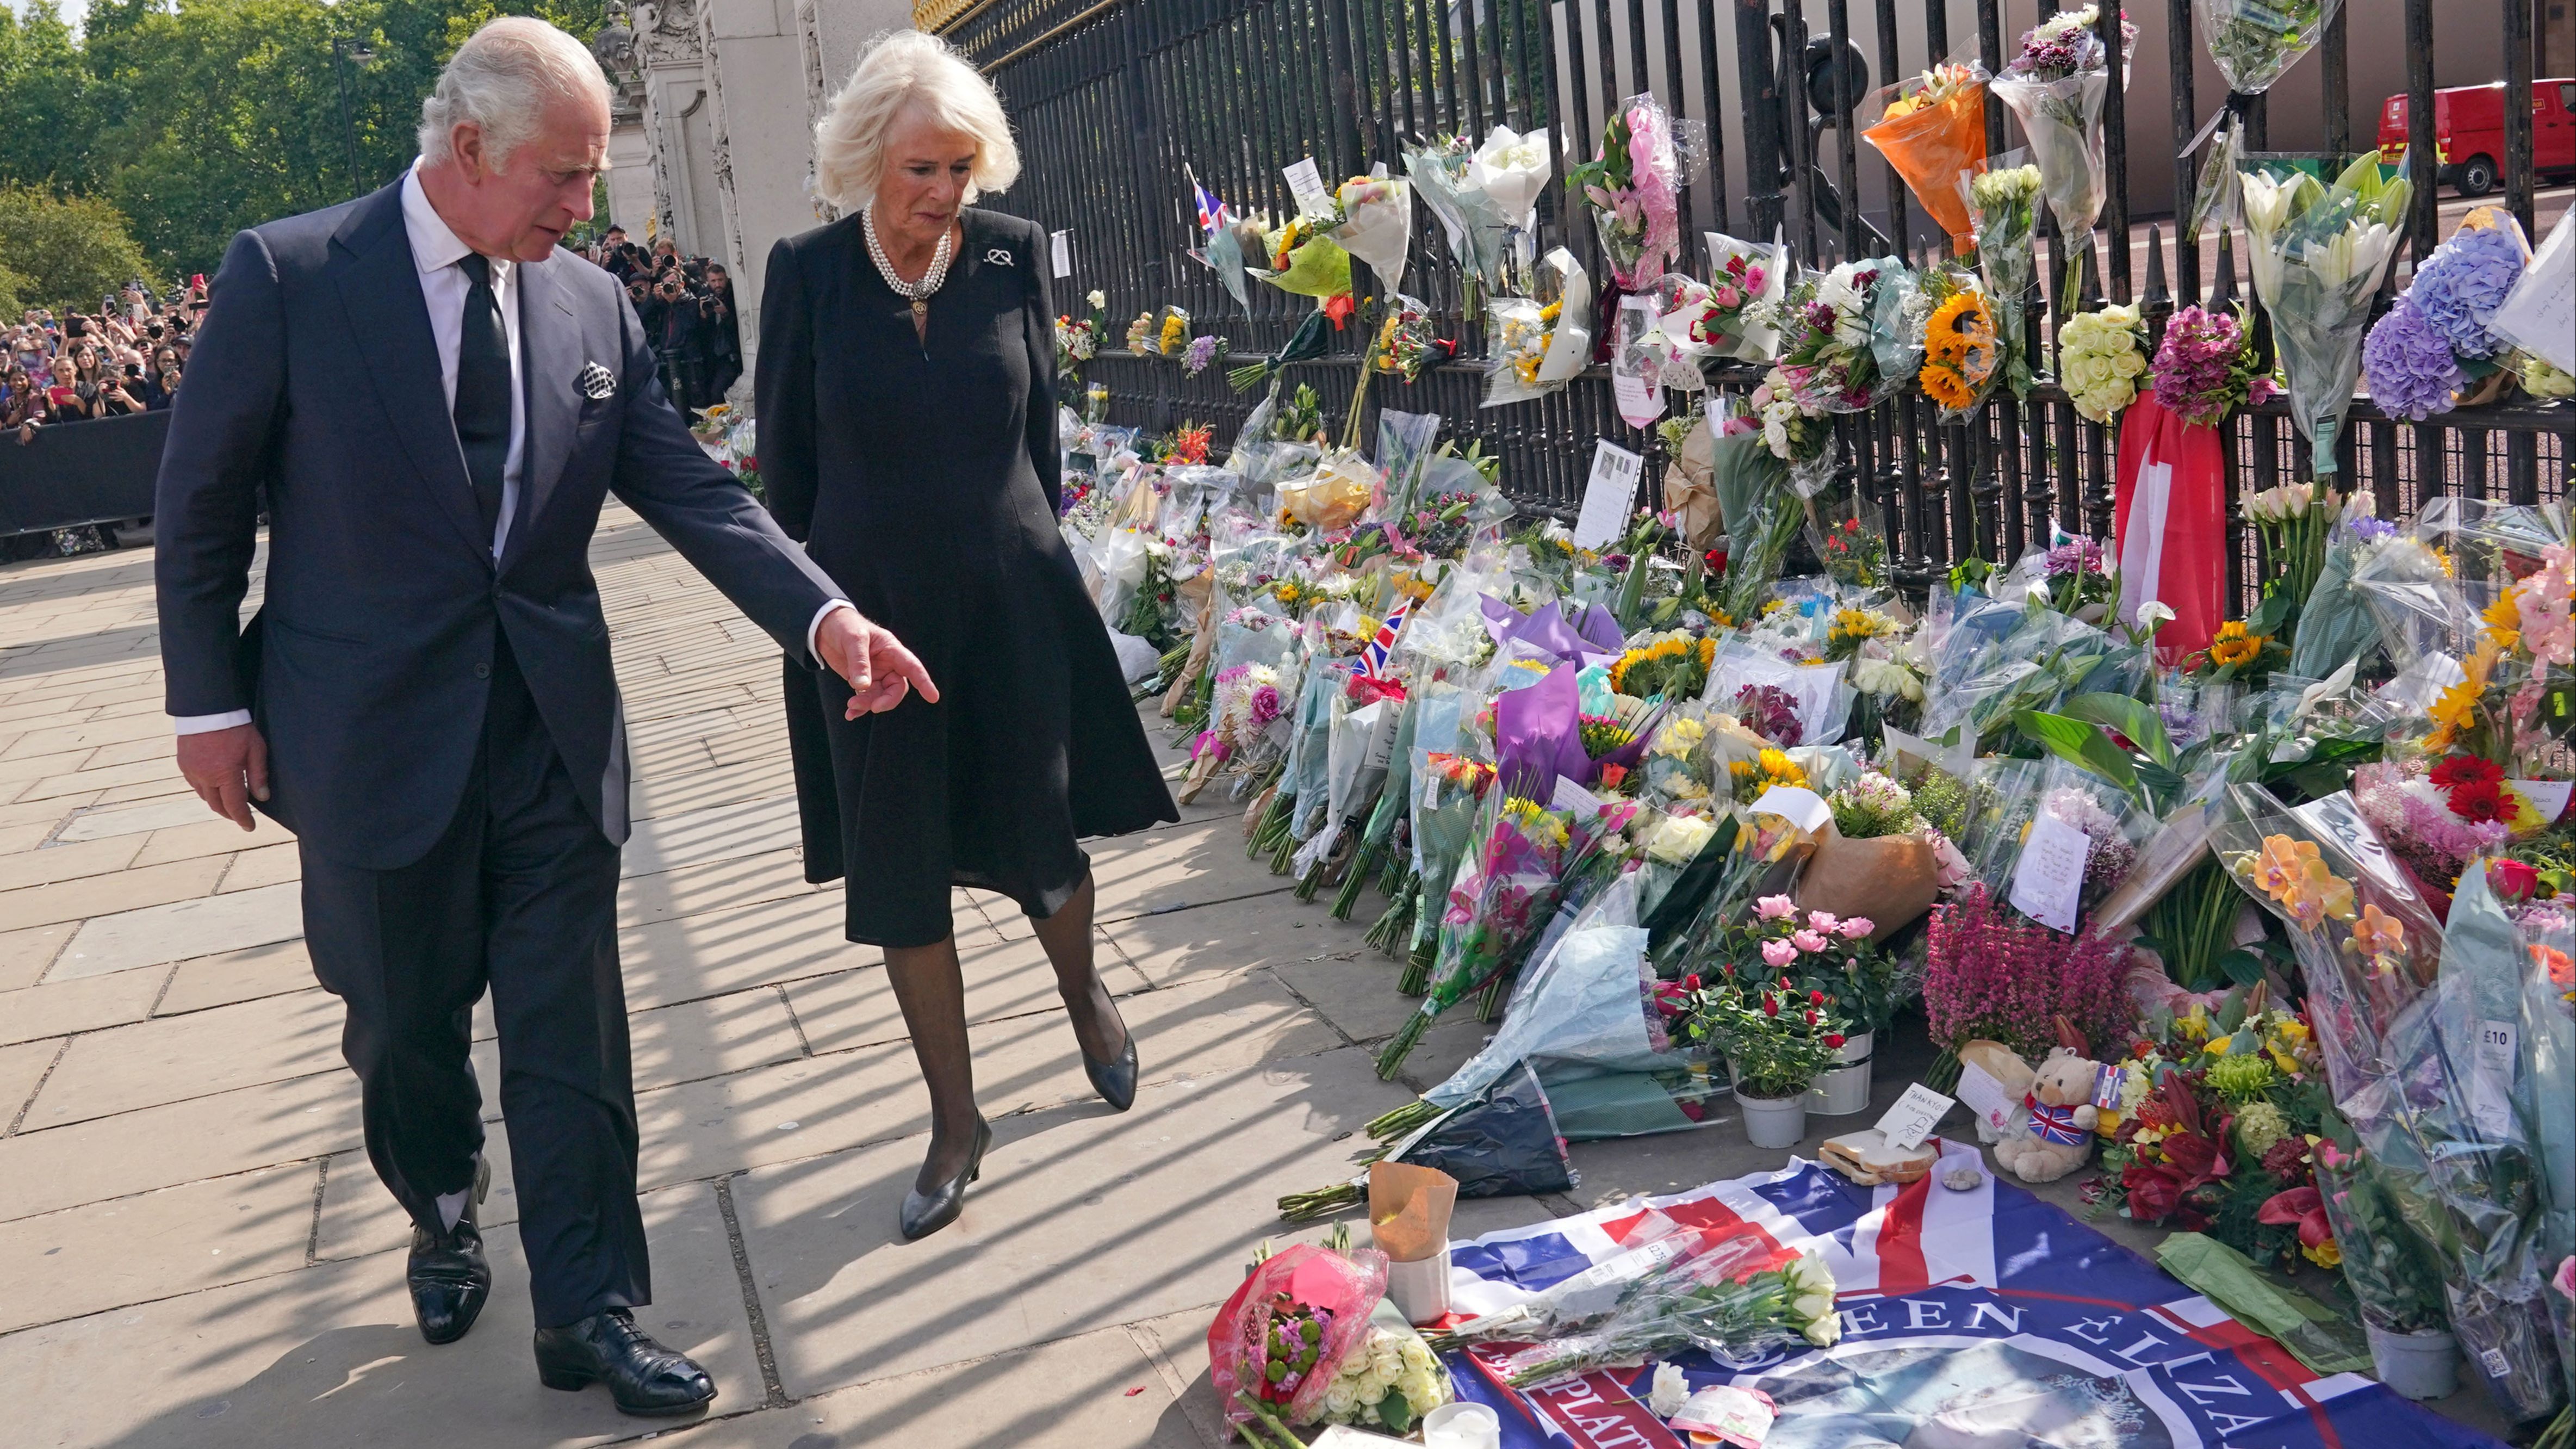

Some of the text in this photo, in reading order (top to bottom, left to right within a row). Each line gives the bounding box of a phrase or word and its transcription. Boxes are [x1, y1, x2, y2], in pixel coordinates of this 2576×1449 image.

[2483, 1030, 2507, 1045] £10
[1648, 1244, 1667, 1261] £2.75
[2061, 1315, 2287, 1449] ELIZA
[1541, 1376, 1656, 1449] PLAT
